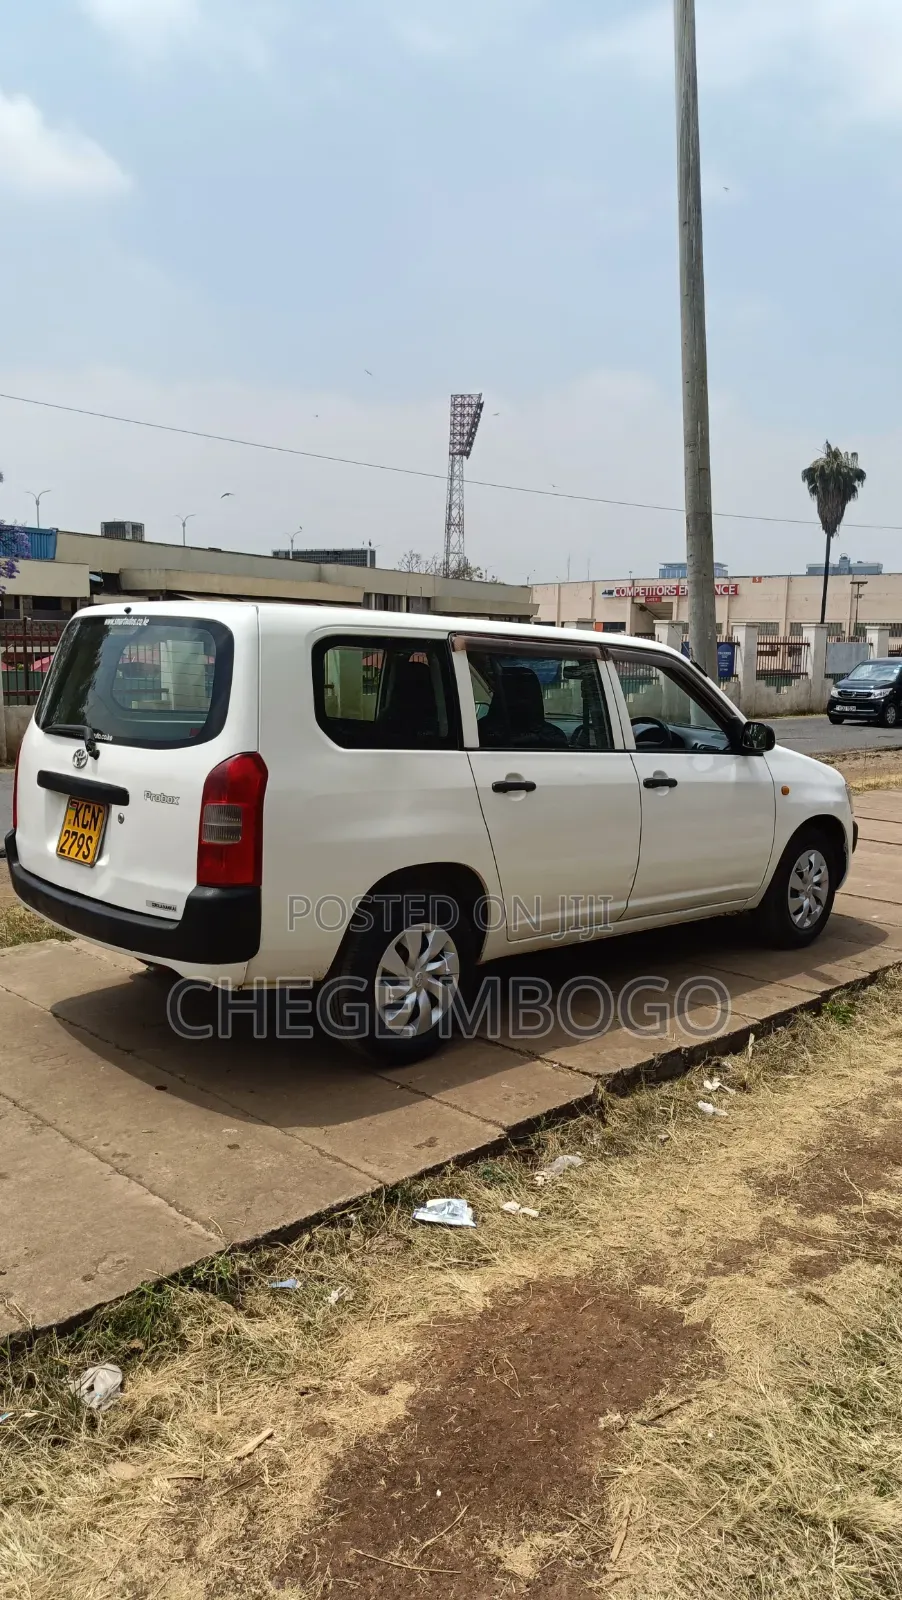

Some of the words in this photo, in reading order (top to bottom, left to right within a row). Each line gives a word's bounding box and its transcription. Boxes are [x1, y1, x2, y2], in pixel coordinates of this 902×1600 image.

[615, 585, 677, 597] COMPETITORS
[678, 584, 736, 596] ENNCE
[143, 789, 181, 806] Probox
[72, 801, 104, 832] KCN
[59, 829, 94, 860] 279S
